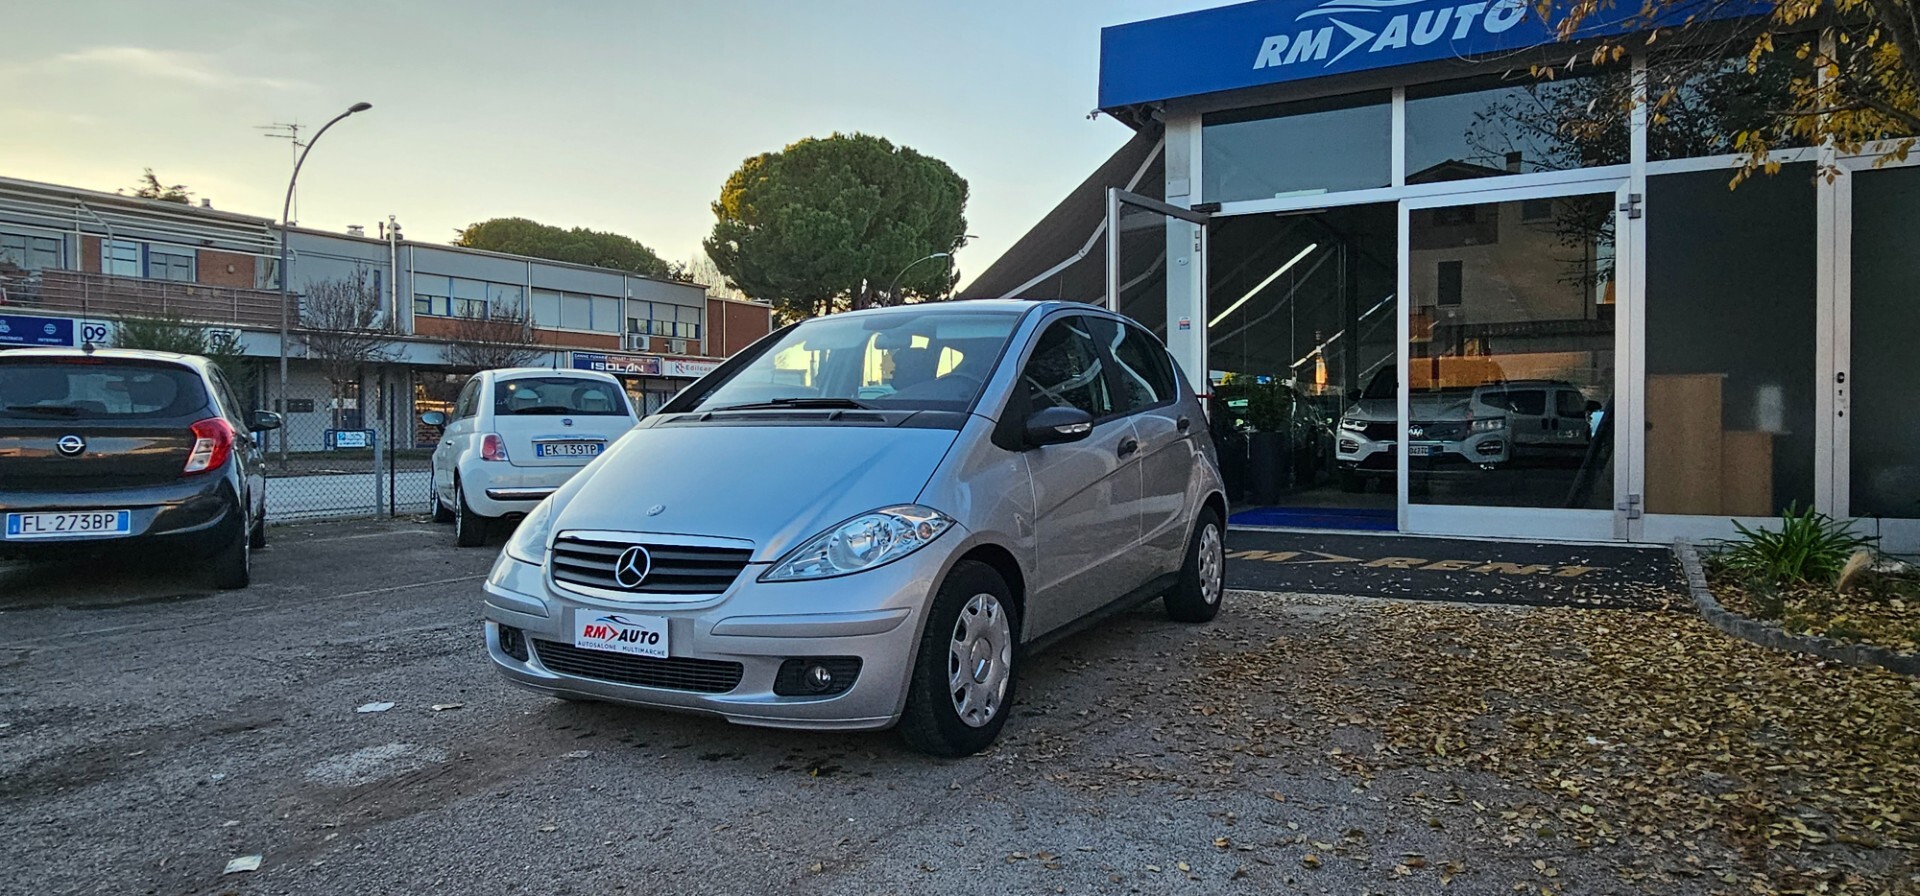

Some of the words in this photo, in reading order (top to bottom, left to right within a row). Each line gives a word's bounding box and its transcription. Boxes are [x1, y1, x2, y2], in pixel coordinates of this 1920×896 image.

[83, 325, 107, 341] 09
[590, 362, 644, 374] ISOLAN
[544, 444, 559, 455] EK
[563, 444, 597, 455] 139TP
[22, 515, 46, 532] FL
[55, 513, 115, 531] 273BP
[618, 629, 660, 645] AUTO
[578, 641, 616, 650] AUTOSALONE
[623, 646, 665, 656] MULTIMARCHE
